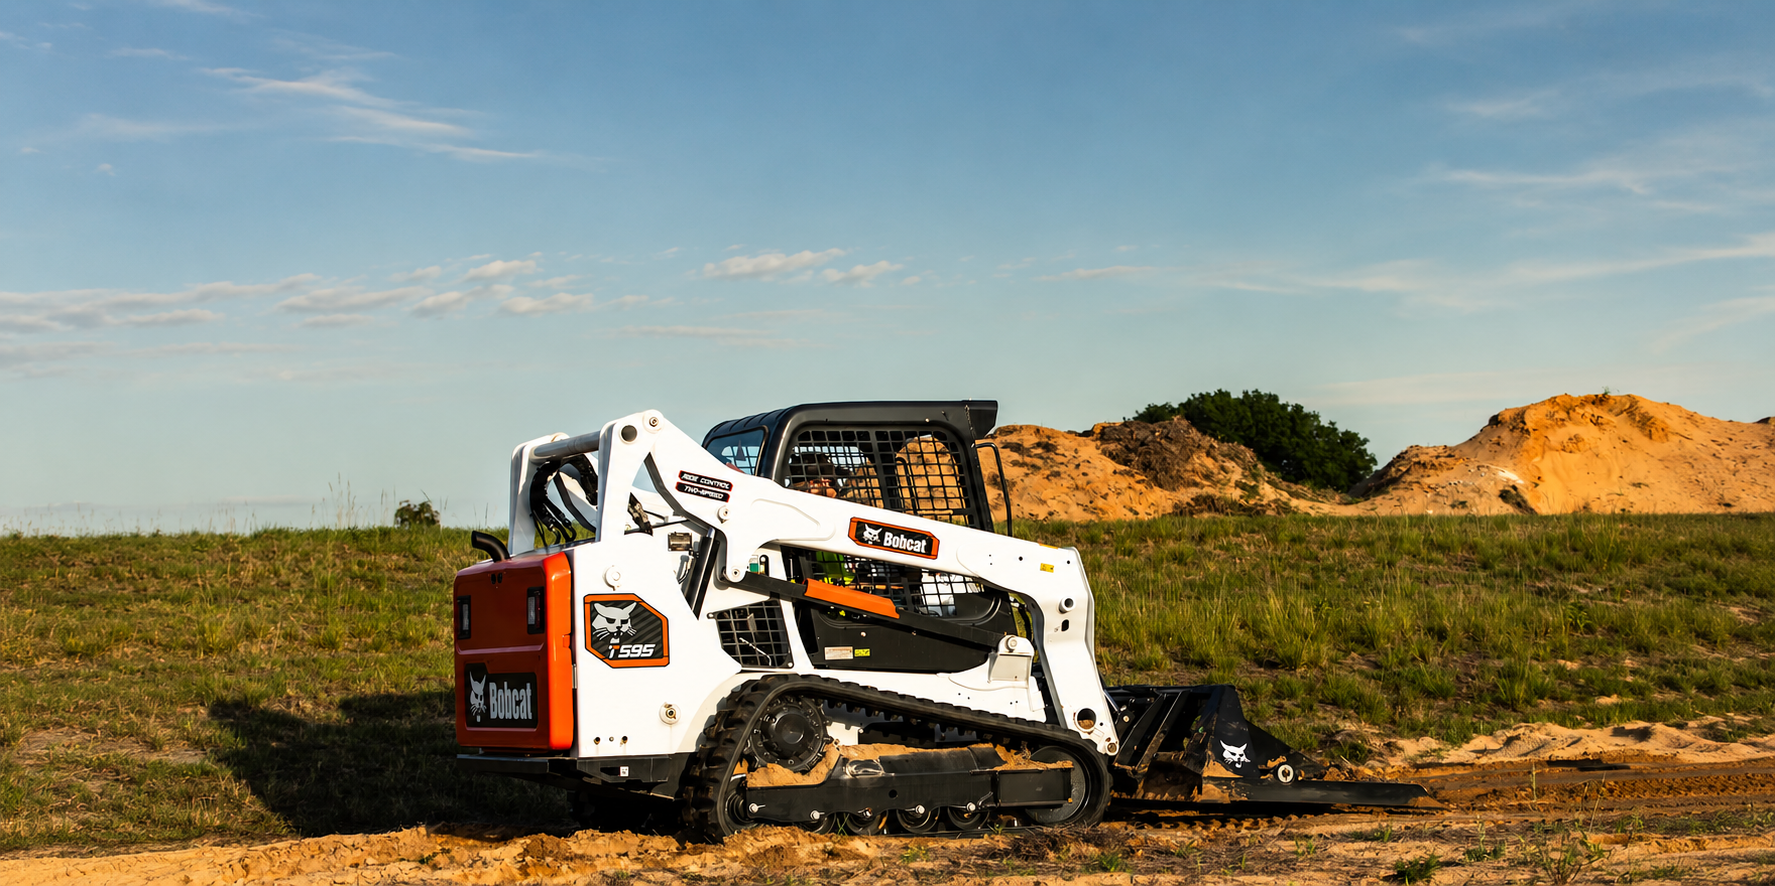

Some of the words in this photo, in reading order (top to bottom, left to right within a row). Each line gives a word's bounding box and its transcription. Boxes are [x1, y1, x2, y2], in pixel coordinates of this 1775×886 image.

[684, 486, 723, 499] TWO-SPEED
[883, 531, 927, 553] Bobcat
[489, 681, 533, 720] Bobcat
